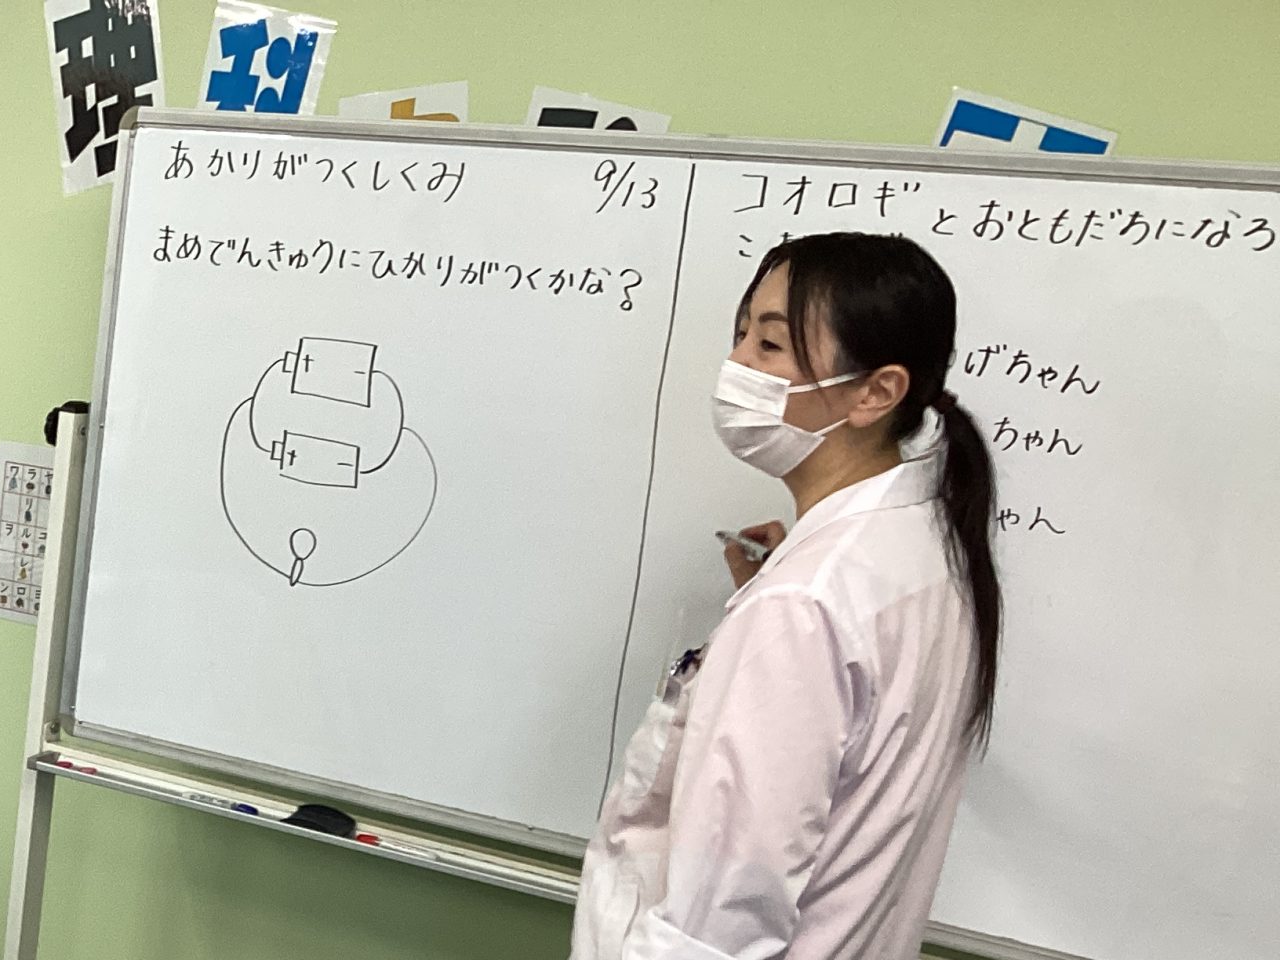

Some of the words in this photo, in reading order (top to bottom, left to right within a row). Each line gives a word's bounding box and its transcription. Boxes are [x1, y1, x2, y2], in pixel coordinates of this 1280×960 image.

[164, 140, 466, 203] あかりがつくしくみ
[593, 159, 660, 214] 9/13
